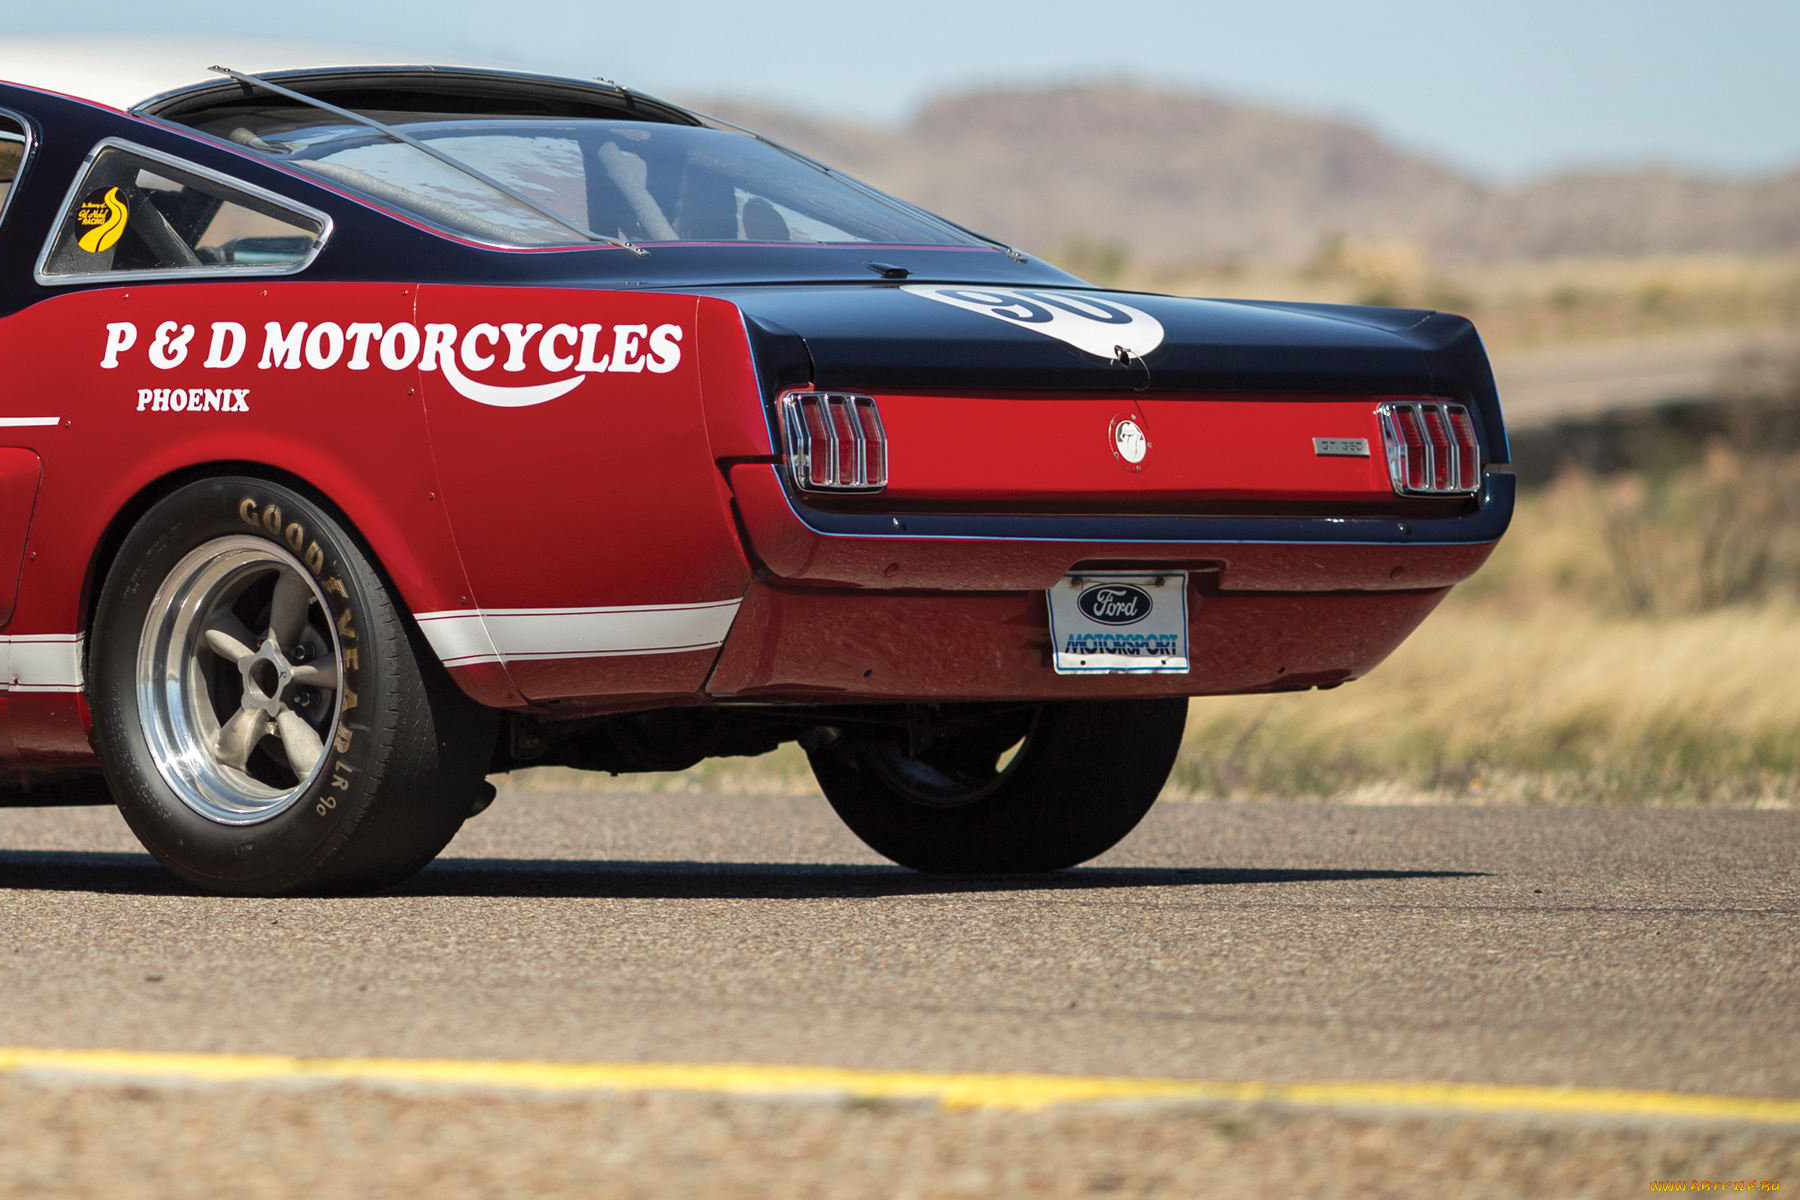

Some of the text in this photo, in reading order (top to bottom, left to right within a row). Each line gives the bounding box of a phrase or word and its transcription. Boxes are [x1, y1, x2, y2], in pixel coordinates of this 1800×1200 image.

[935, 289, 1133, 325] 90
[100, 321, 683, 407] P & D MOTORCYCLES
[136, 388, 250, 412] PHOENIX
[1093, 588, 1138, 616] Ford
[239, 498, 360, 754] GOODYEAR
[1064, 633, 1179, 655] MOTORSPORT
